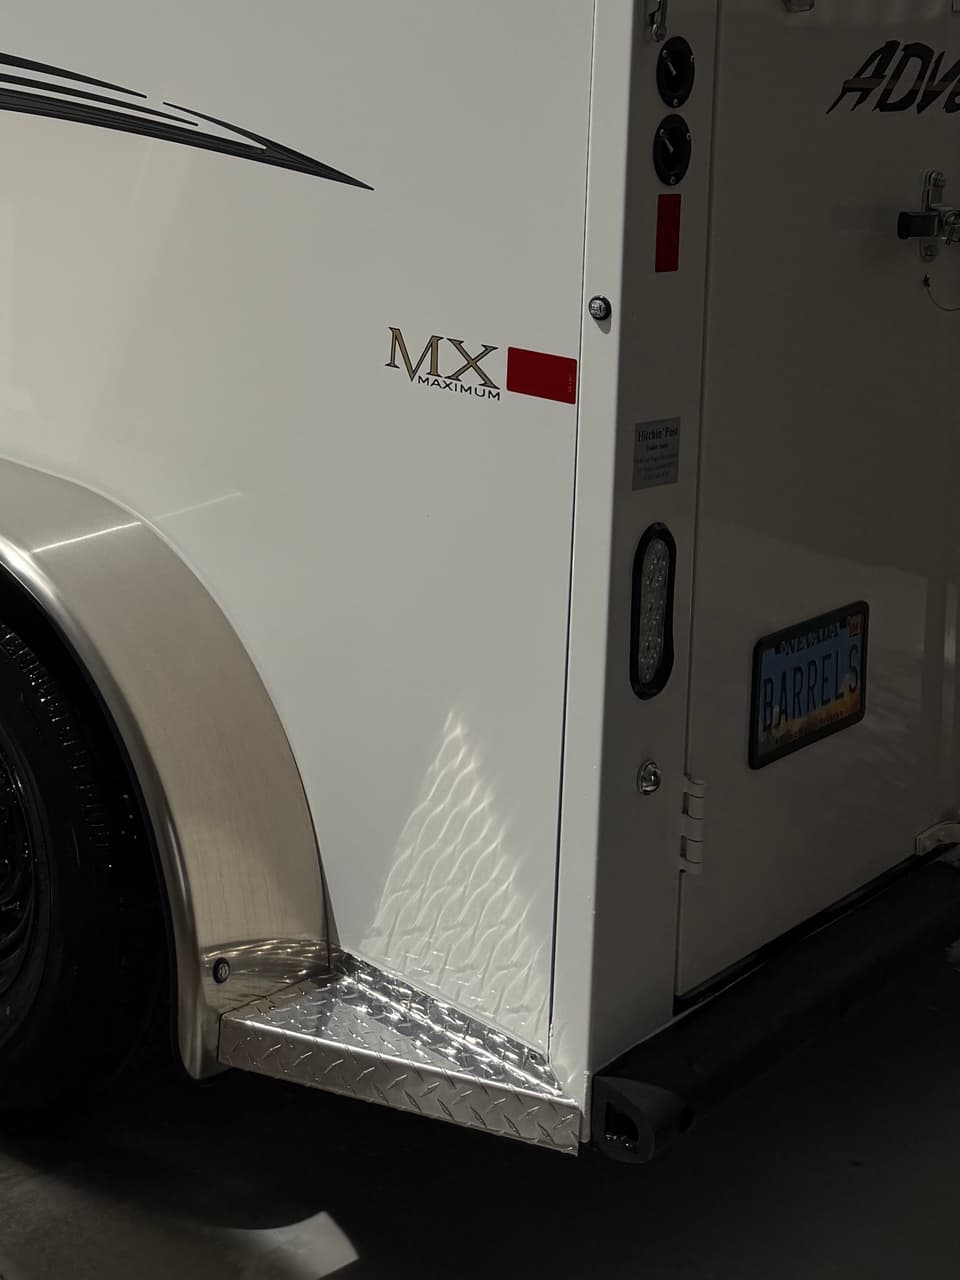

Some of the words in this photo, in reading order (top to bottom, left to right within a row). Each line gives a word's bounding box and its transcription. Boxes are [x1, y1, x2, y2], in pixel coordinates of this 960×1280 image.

[385, 327, 501, 389] MX
[417, 375, 502, 401] MAXIMUM
[762, 644, 859, 731] BARRELS
